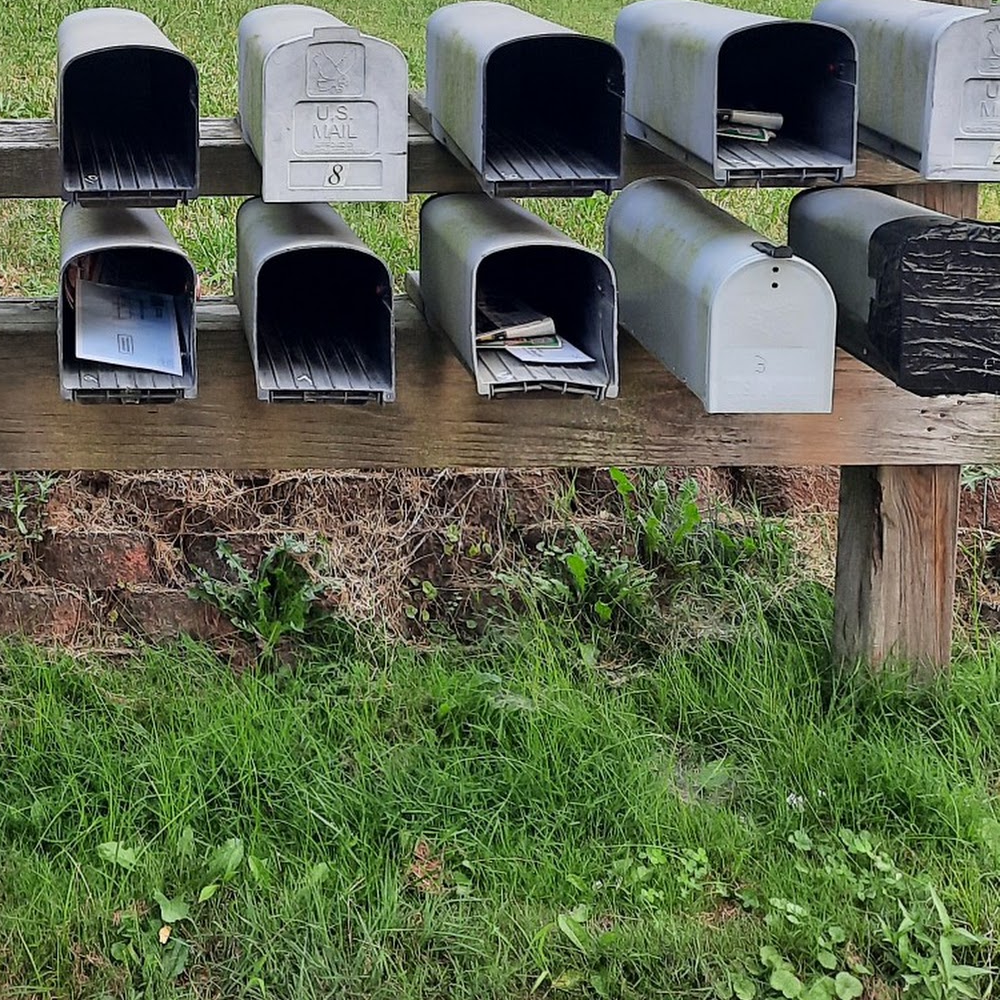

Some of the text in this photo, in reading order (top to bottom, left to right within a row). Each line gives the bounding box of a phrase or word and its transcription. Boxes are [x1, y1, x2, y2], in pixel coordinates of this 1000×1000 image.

[316, 105, 353, 121] U.S.
[312, 124, 358, 139] MAIL
[328, 164, 343, 185] 8
